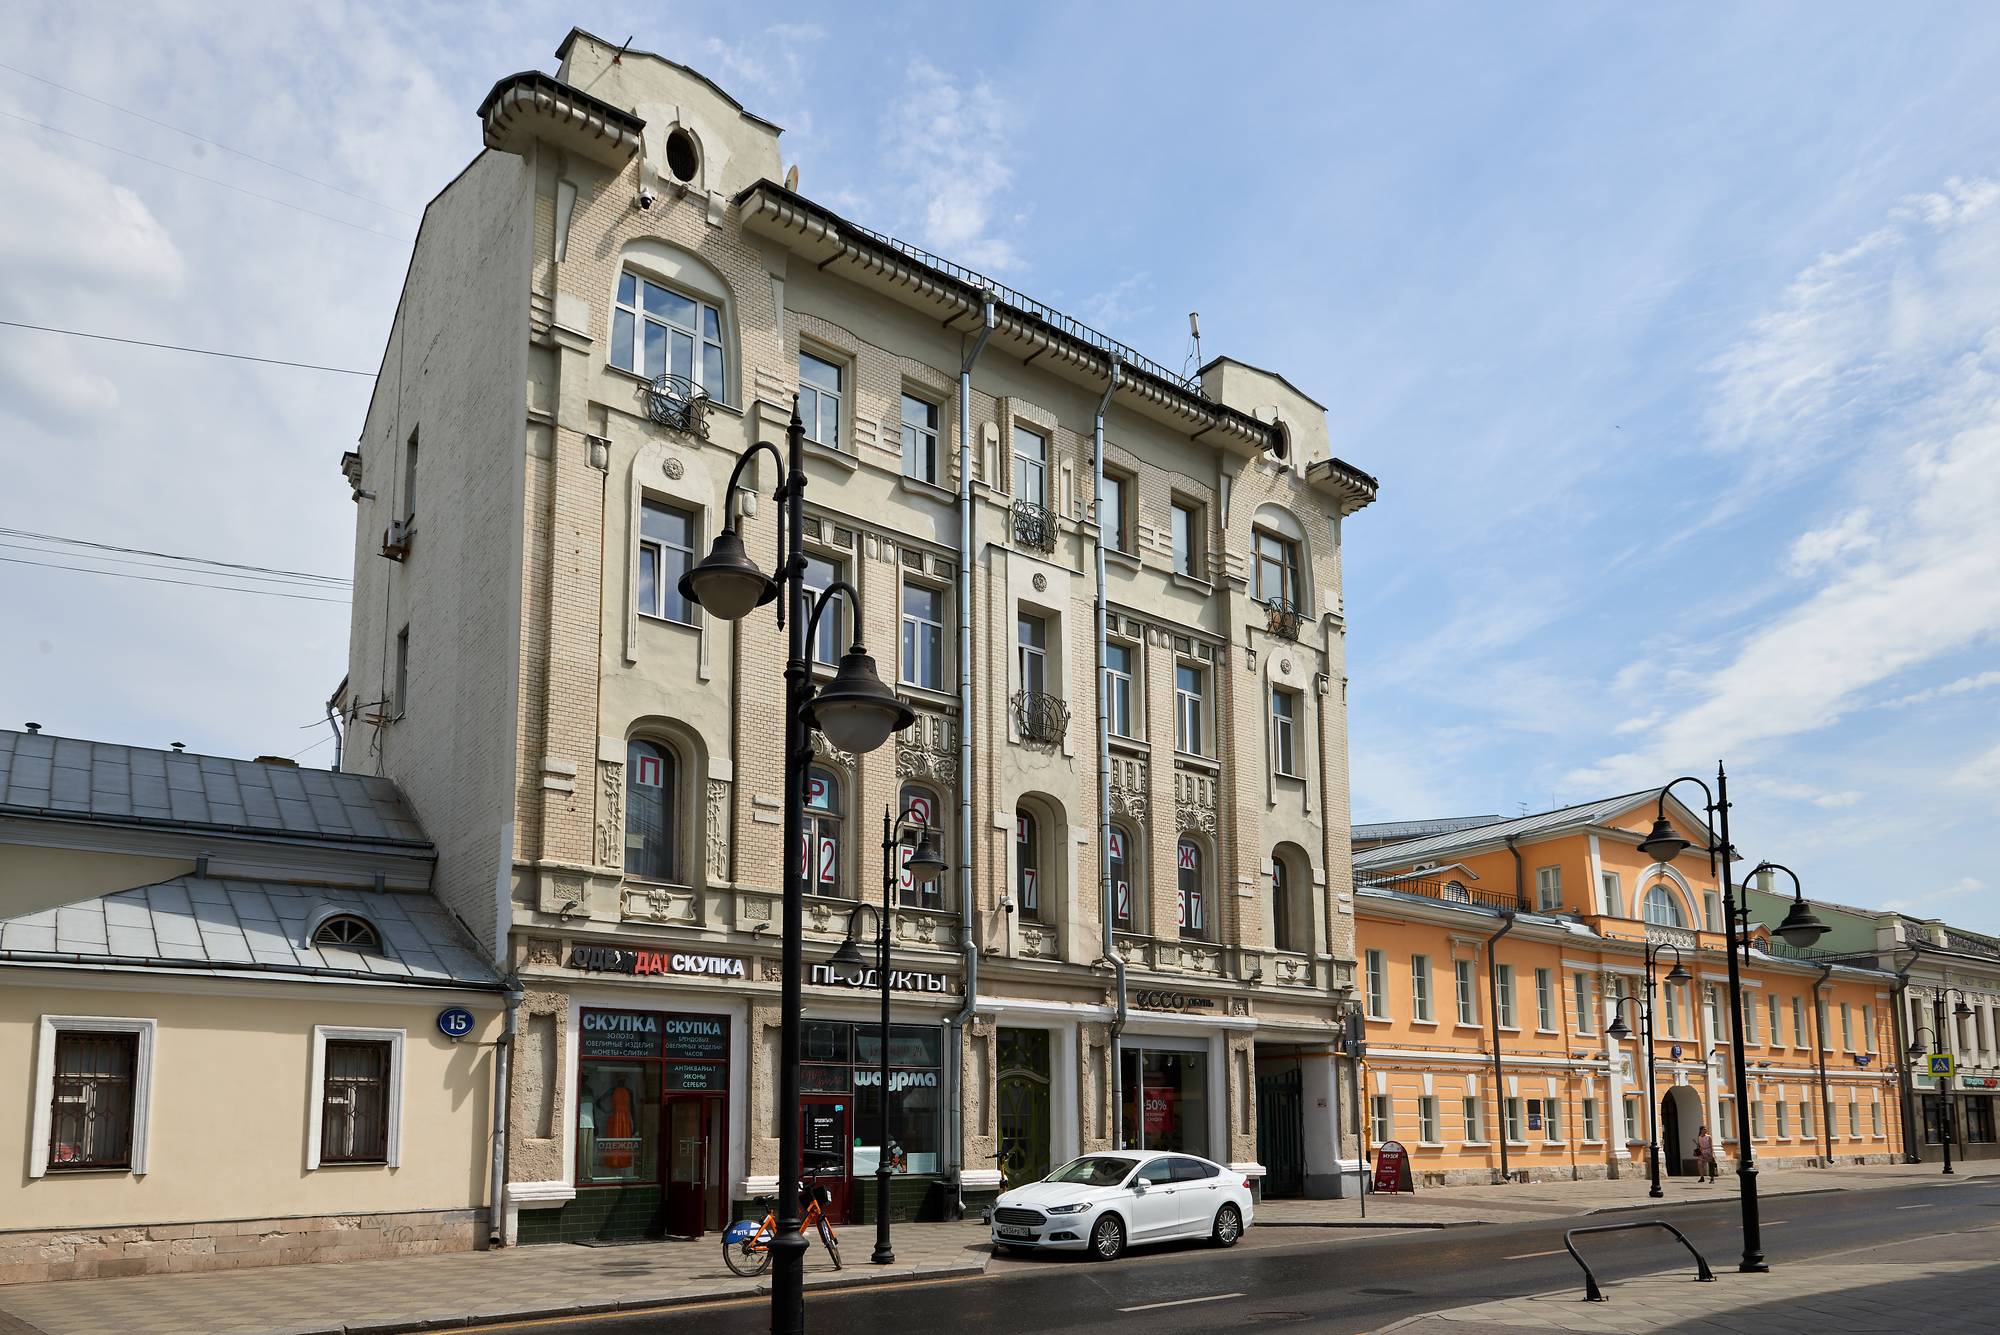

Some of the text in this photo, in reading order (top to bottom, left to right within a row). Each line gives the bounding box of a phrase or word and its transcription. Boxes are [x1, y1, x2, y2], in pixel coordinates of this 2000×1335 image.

[640, 756, 659, 785] П
[910, 798, 929, 823] О
[1178, 846, 1195, 869] Ж
[821, 841, 835, 881] 2
[1024, 870, 1036, 906] 7
[1119, 884, 1128, 918] 2
[672, 953, 745, 977] СКУПКА
[448, 1014, 467, 1030] 15
[583, 1014, 657, 1033] СКУПКА
[666, 1019, 721, 1035] СКУПКА
[607, 1032, 635, 1040] ЗОЛОТО
[682, 1081, 708, 1089] СЕРЕБРО
